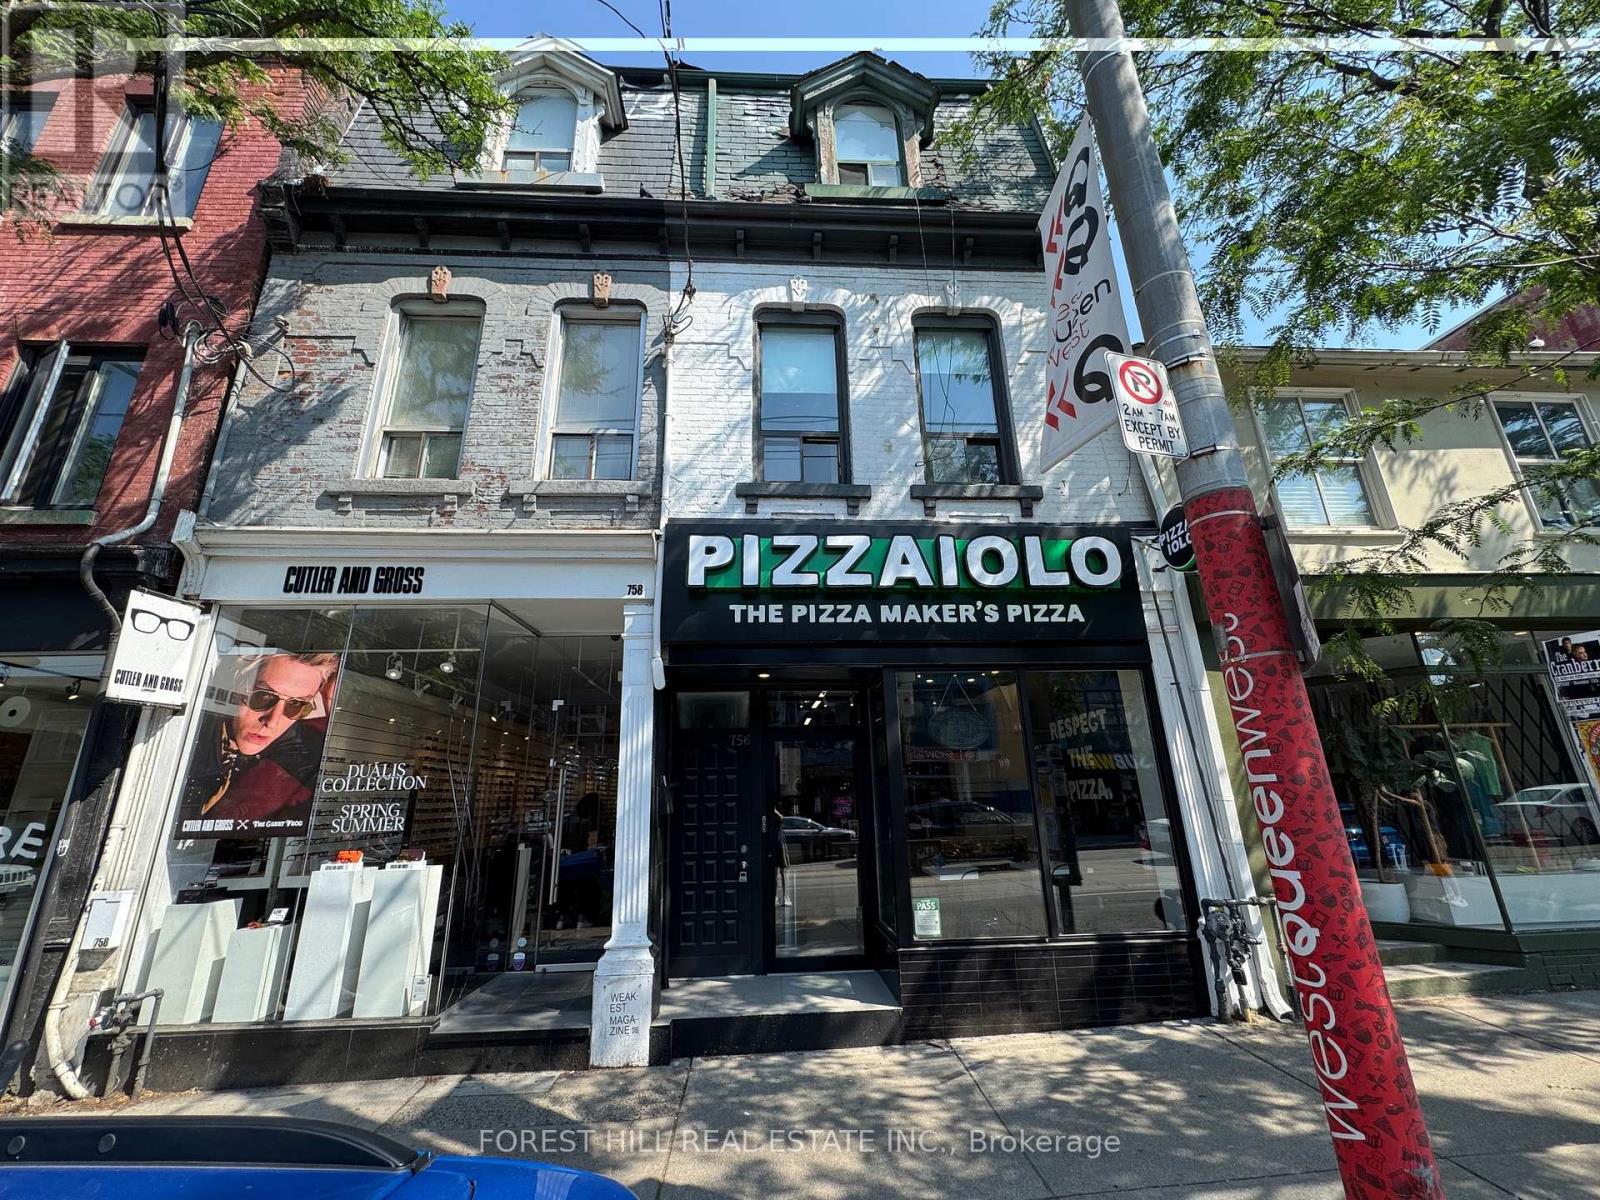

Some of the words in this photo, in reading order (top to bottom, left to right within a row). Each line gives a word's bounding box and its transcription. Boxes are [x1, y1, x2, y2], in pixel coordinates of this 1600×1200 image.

[1123, 403, 1144, 418] 2AM
[1157, 408, 1176, 423] 7AM
[1124, 420, 1162, 436] EXCEPT
[1167, 427, 1181, 439] BY
[1138, 436, 1174, 453] PERMIT
[687, 535, 1122, 587] PIZZAIOLO
[283, 566, 337, 593] CUTLER
[337, 567, 372, 594] AND
[373, 566, 425, 594] GROSS
[627, 584, 644, 596] 758
[729, 604, 783, 624] THE
[791, 604, 872, 624] PIZZA
[1007, 604, 1085, 623] PIZZA
[1555, 651, 1567, 662] The
[115, 669, 142, 687] CUTLER
[142, 673, 160, 689] AND
[160, 676, 183, 692] GROSS
[1049, 708, 1106, 740] RESPECT
[729, 734, 751, 746] 756
[322, 776, 428, 792] COLLECTION
[340, 803, 400, 819] SPRING
[331, 817, 405, 833] SUMMER
[916, 902, 936, 910] PASS
[93, 937, 110, 948] 758
[609, 1003, 627, 1013] EST
[609, 1015, 639, 1026] MAGA-
[609, 1026, 630, 1036] ZINE
